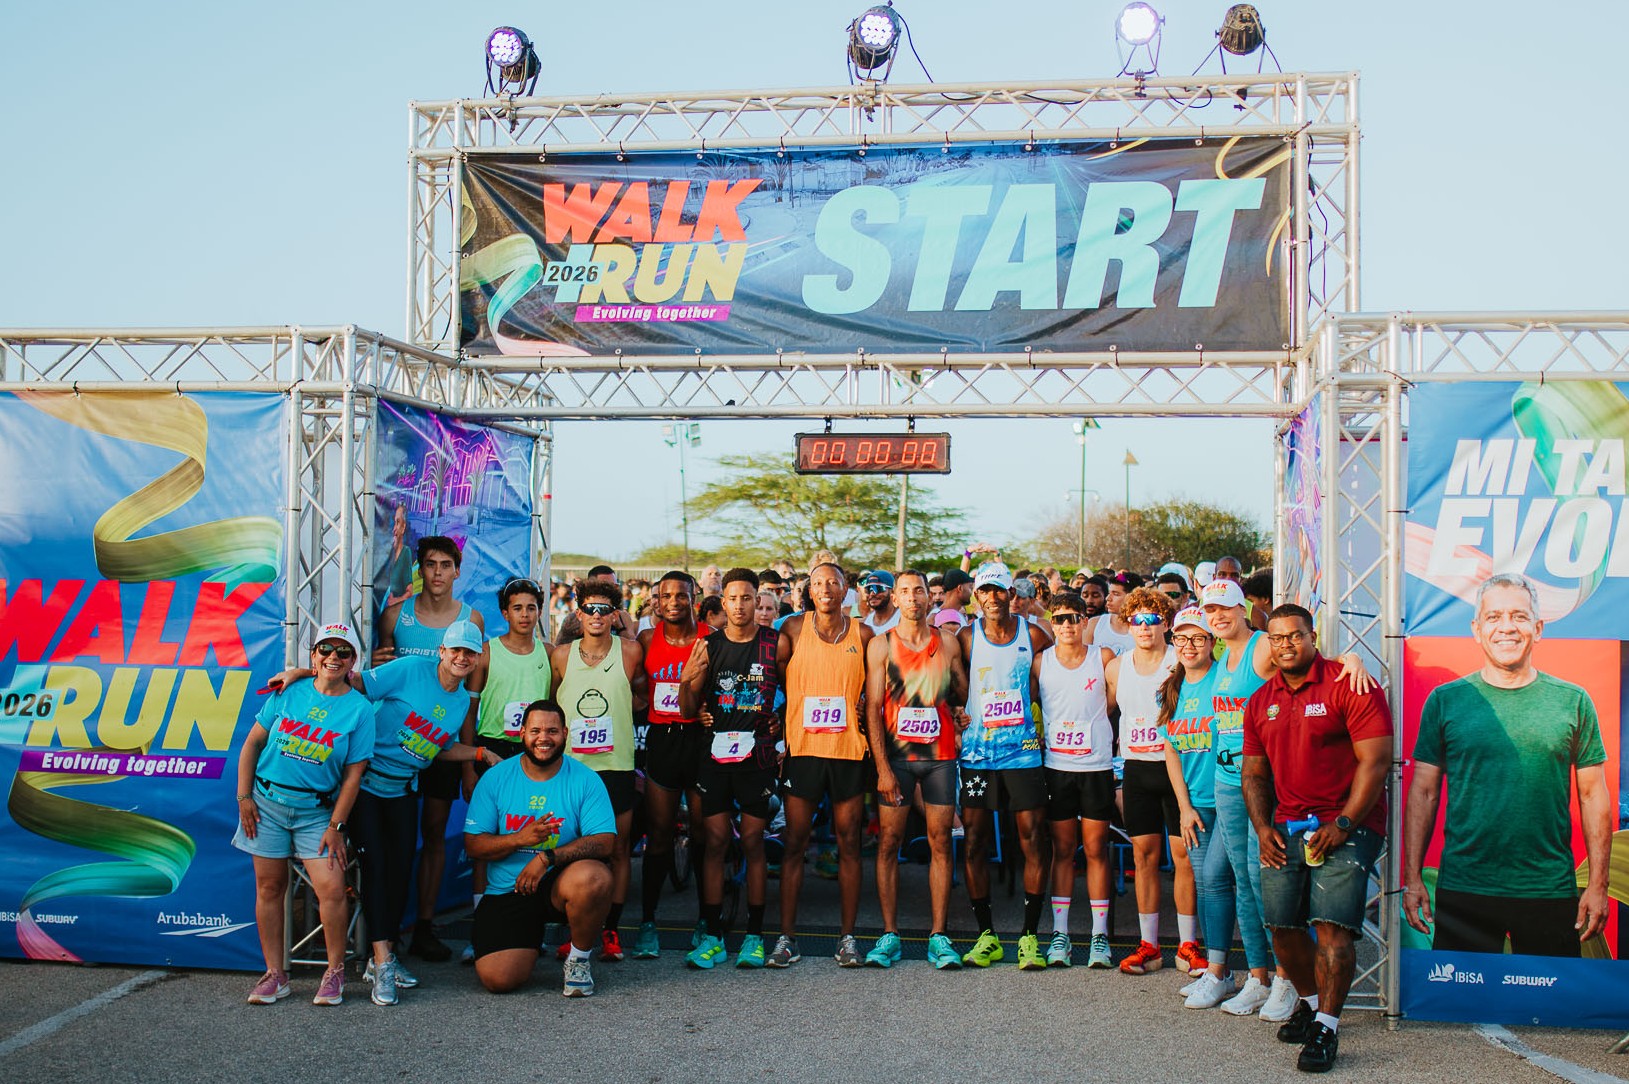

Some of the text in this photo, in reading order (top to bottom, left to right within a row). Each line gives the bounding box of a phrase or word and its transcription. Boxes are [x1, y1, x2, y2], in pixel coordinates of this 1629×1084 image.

[543, 178, 765, 245] WALK
[801, 177, 1267, 315] START
[548, 265, 599, 283] 2026
[578, 243, 749, 304] RUN
[592, 306, 718, 322] Evolving together
[1444, 438, 1627, 496] MI TA
[0, 578, 272, 668] WALK
[737, 674, 764, 682] C-Jam
[0, 692, 53, 718] 026
[307, 706, 328, 719] 20
[432, 704, 446, 718] 20
[984, 700, 1022, 718] 2504
[1213, 696, 1248, 713] ALK
[811, 708, 841, 724] 819
[278, 717, 343, 749] WALK
[900, 719, 939, 734] 2503
[1131, 727, 1158, 743] 916
[1166, 716, 1215, 737] WALK
[579, 728, 607, 745] 195
[1056, 731, 1085, 746] 913
[1176, 732, 1212, 751] RUN
[282, 735, 334, 763] RUN
[728, 742, 739, 755] 4
[41, 752, 207, 776] Evolving together
[530, 795, 547, 806] 20
[34, 913, 79, 925] SUBWAY
[157, 911, 230, 928] Arubabank
[1455, 971, 1558, 987] IBiSA SUBWAY
